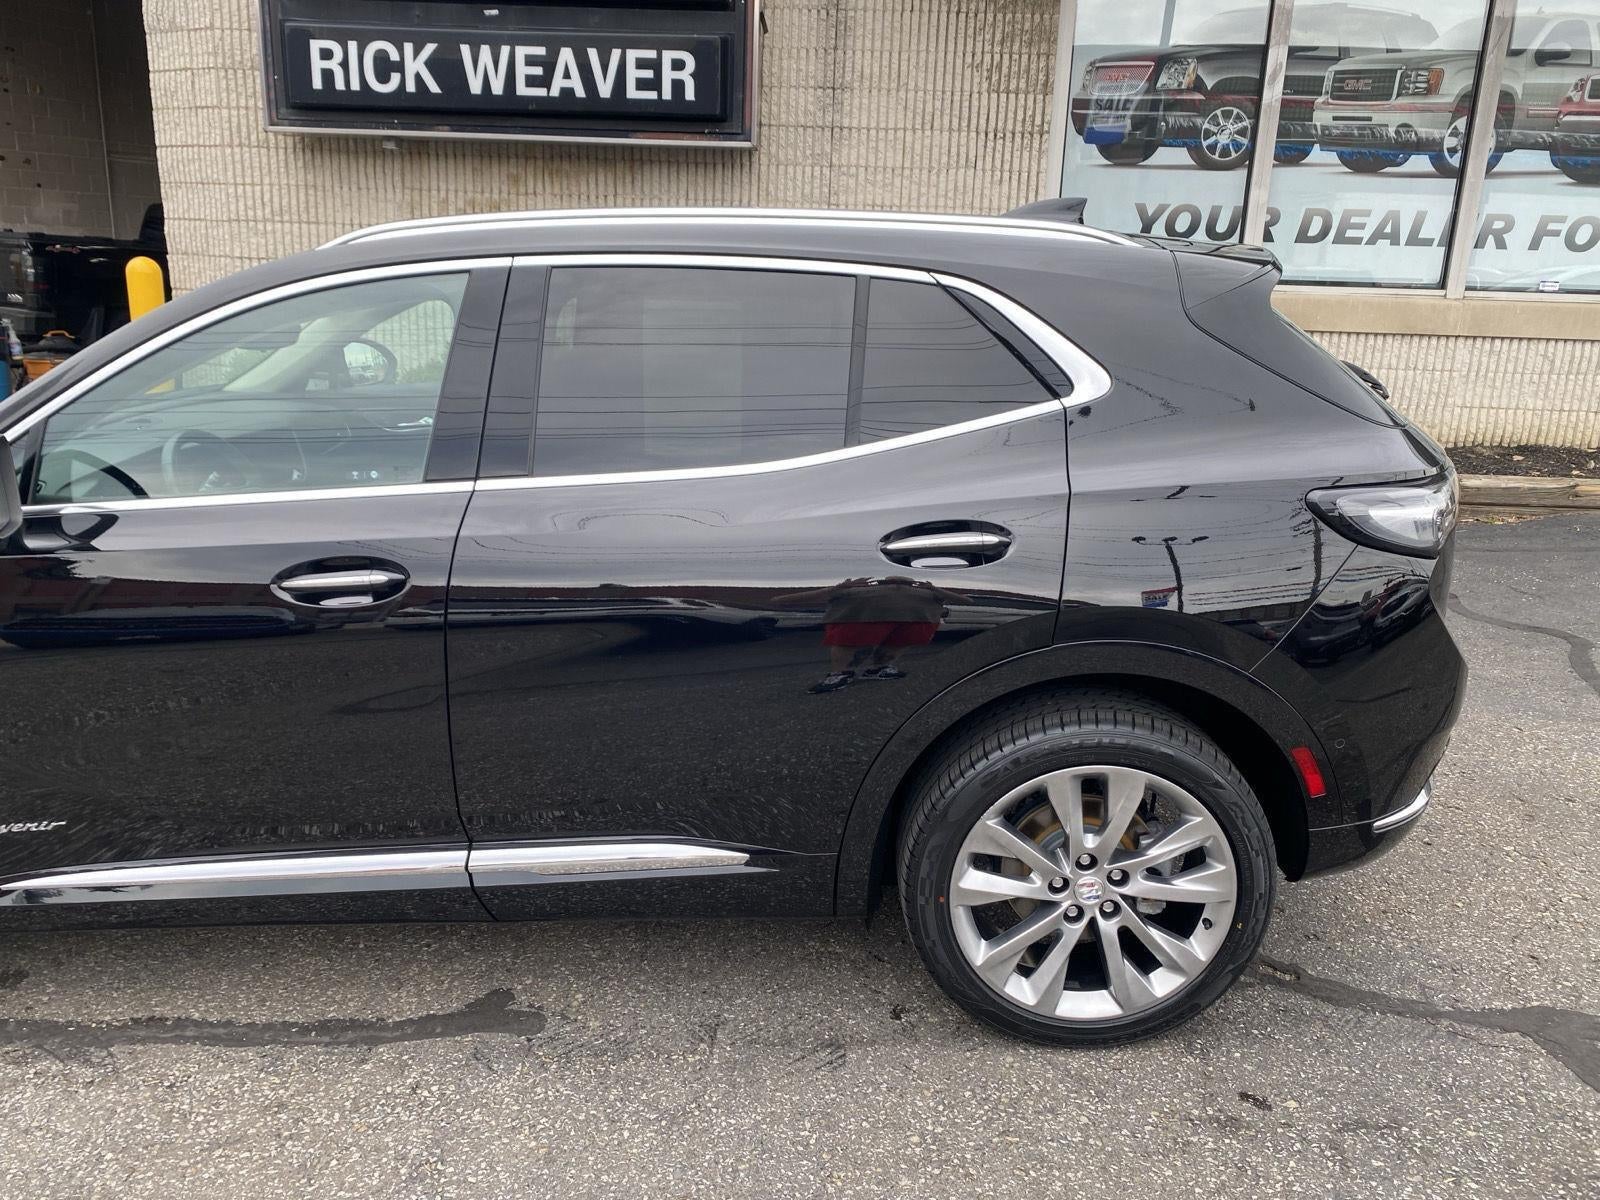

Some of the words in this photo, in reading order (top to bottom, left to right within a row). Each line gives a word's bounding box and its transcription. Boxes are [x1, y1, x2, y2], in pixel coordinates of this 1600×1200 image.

[309, 39, 442, 94] RICK
[459, 43, 697, 101] WEAVER
[1344, 79, 1372, 90] GMC
[1134, 202, 1281, 243] YOUR
